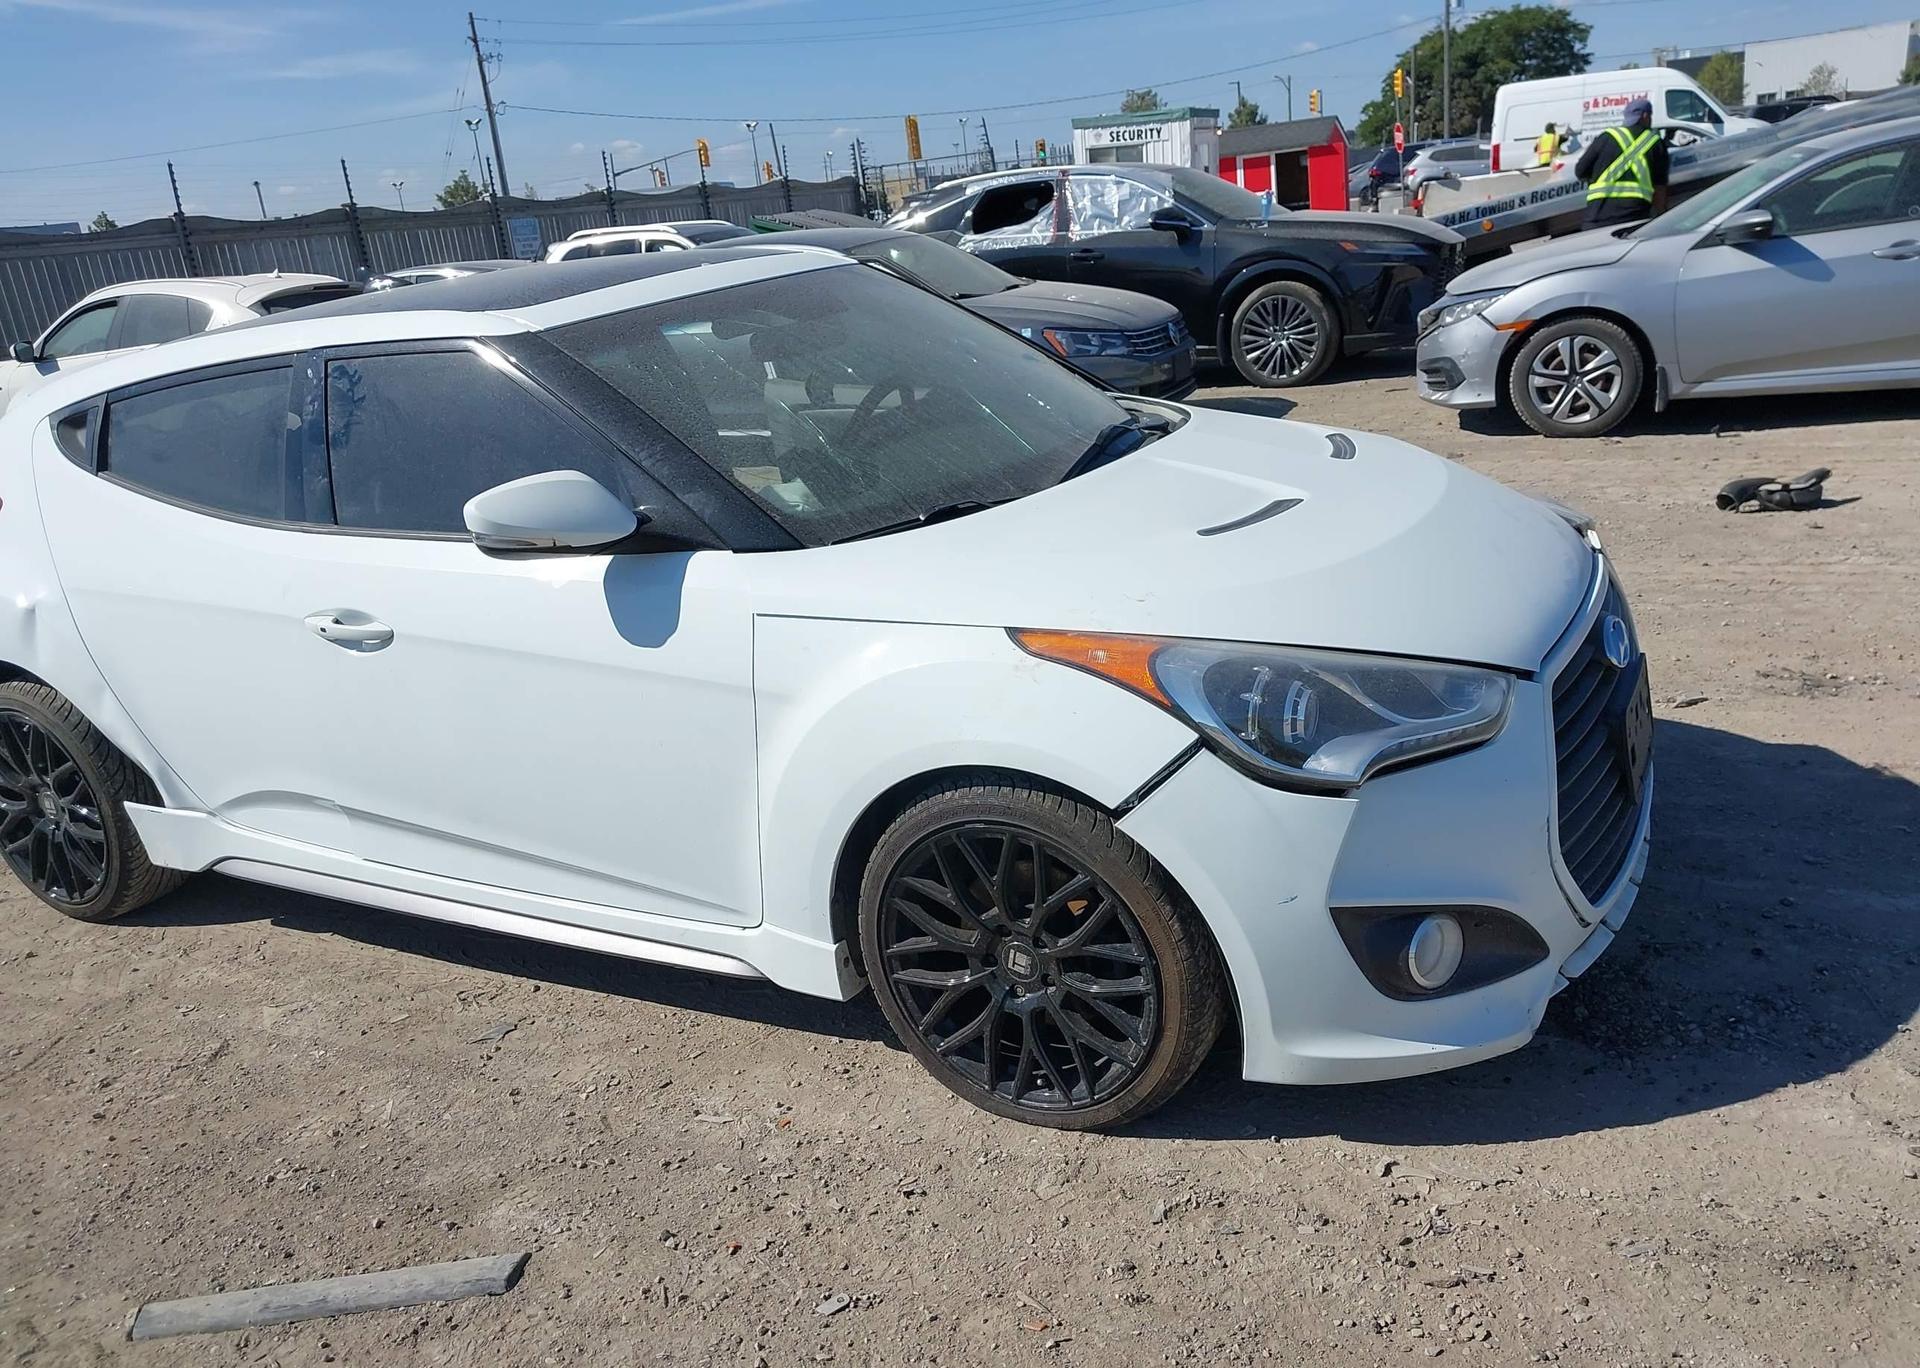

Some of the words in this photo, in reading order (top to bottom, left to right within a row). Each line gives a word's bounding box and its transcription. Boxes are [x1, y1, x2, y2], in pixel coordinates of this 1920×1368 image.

[1602, 95, 1629, 108] Drain
[1109, 127, 1162, 142] SECURITY
[1443, 213, 1456, 226] 24
[1475, 198, 1515, 219] Towing
[1518, 195, 1527, 208] &
[1531, 180, 1588, 205] Recover
